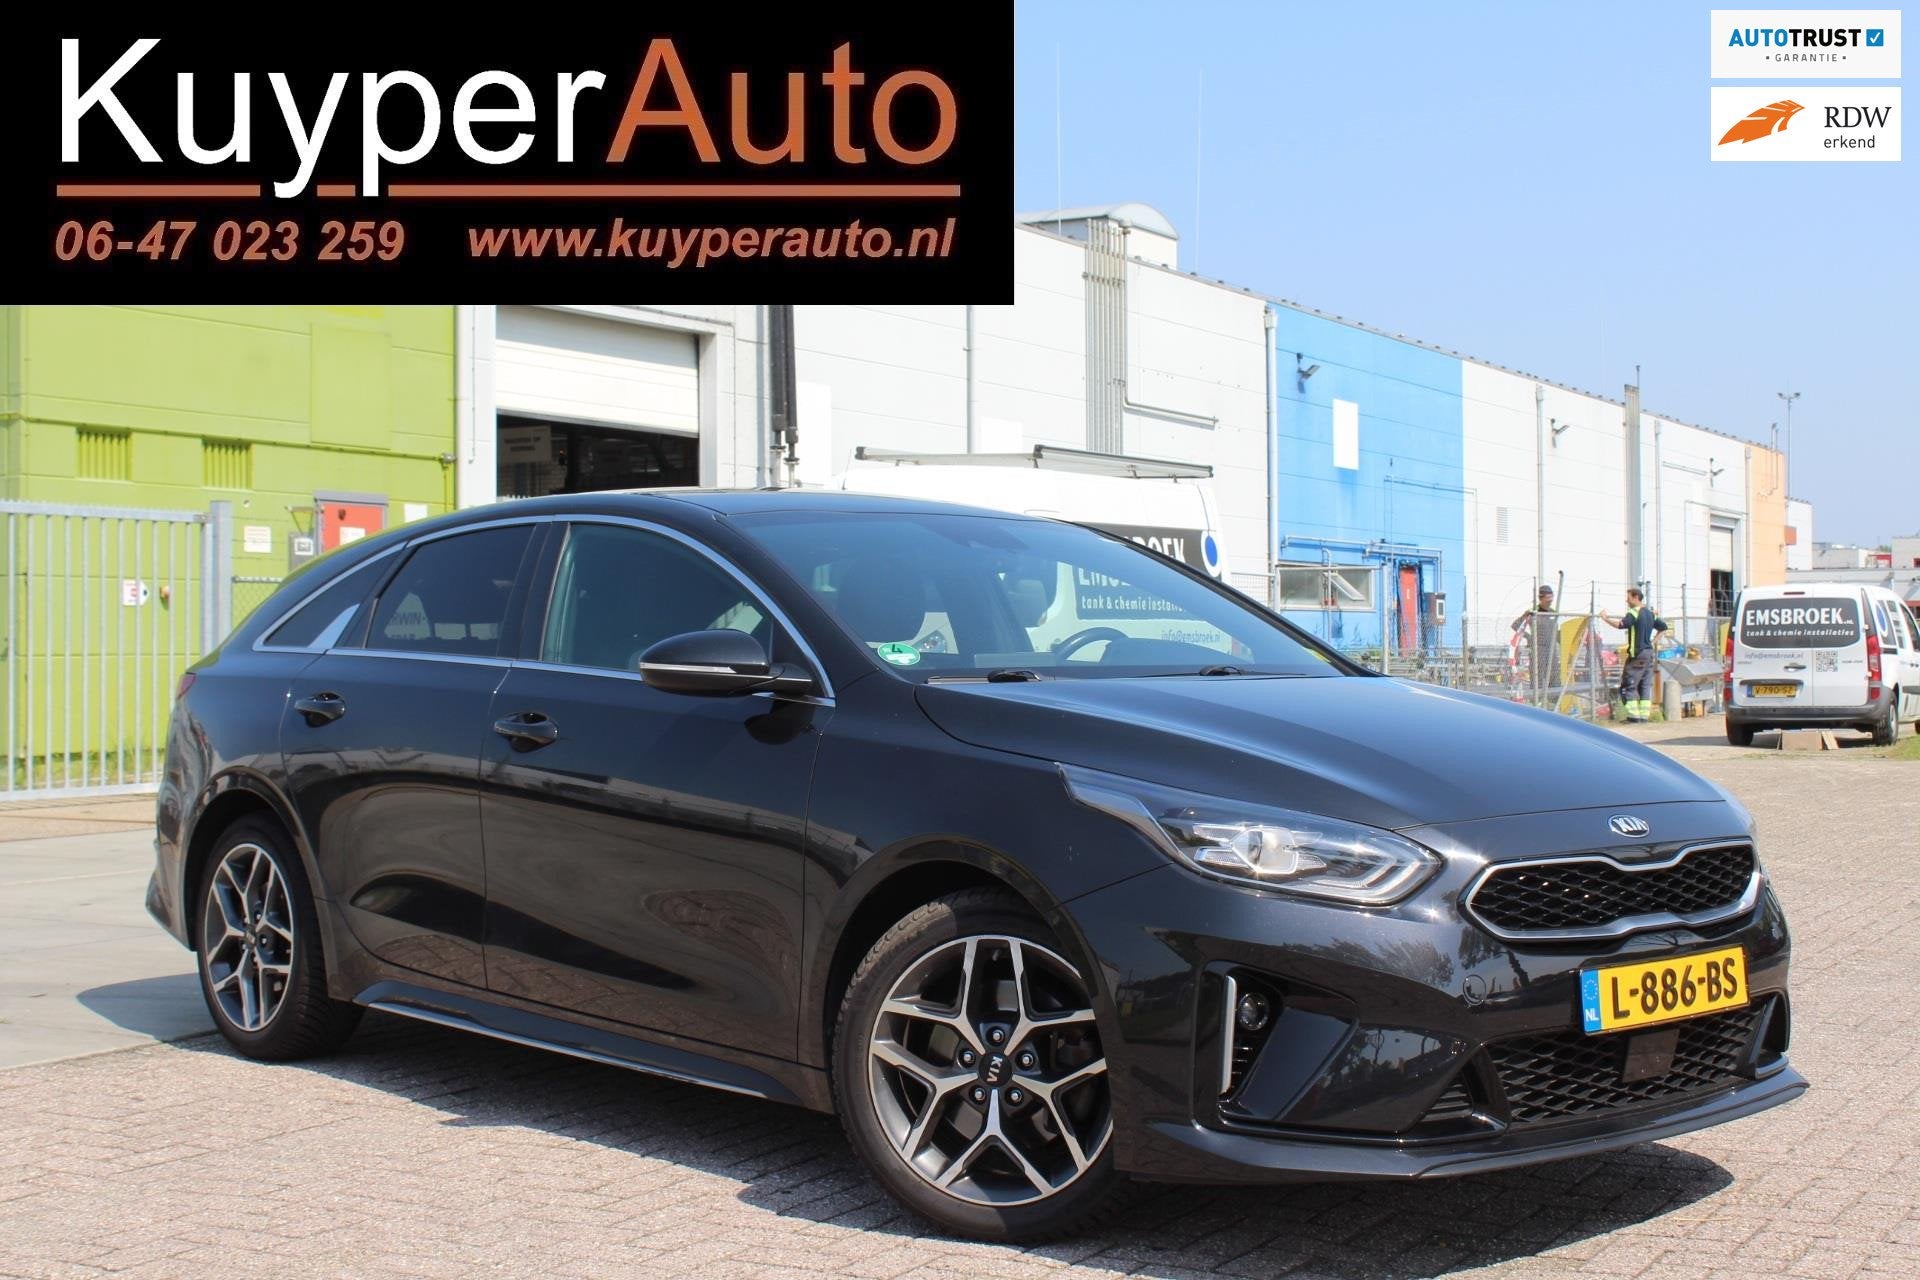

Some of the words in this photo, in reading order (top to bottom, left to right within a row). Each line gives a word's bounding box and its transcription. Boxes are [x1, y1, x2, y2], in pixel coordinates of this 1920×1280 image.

[1082, 596, 1104, 609] tank
[1106, 597, 1112, 609] &
[1114, 596, 1146, 610] chemie
[1612, 957, 1738, 1020] L-886-BS
[1585, 1008, 1599, 1021] NL
